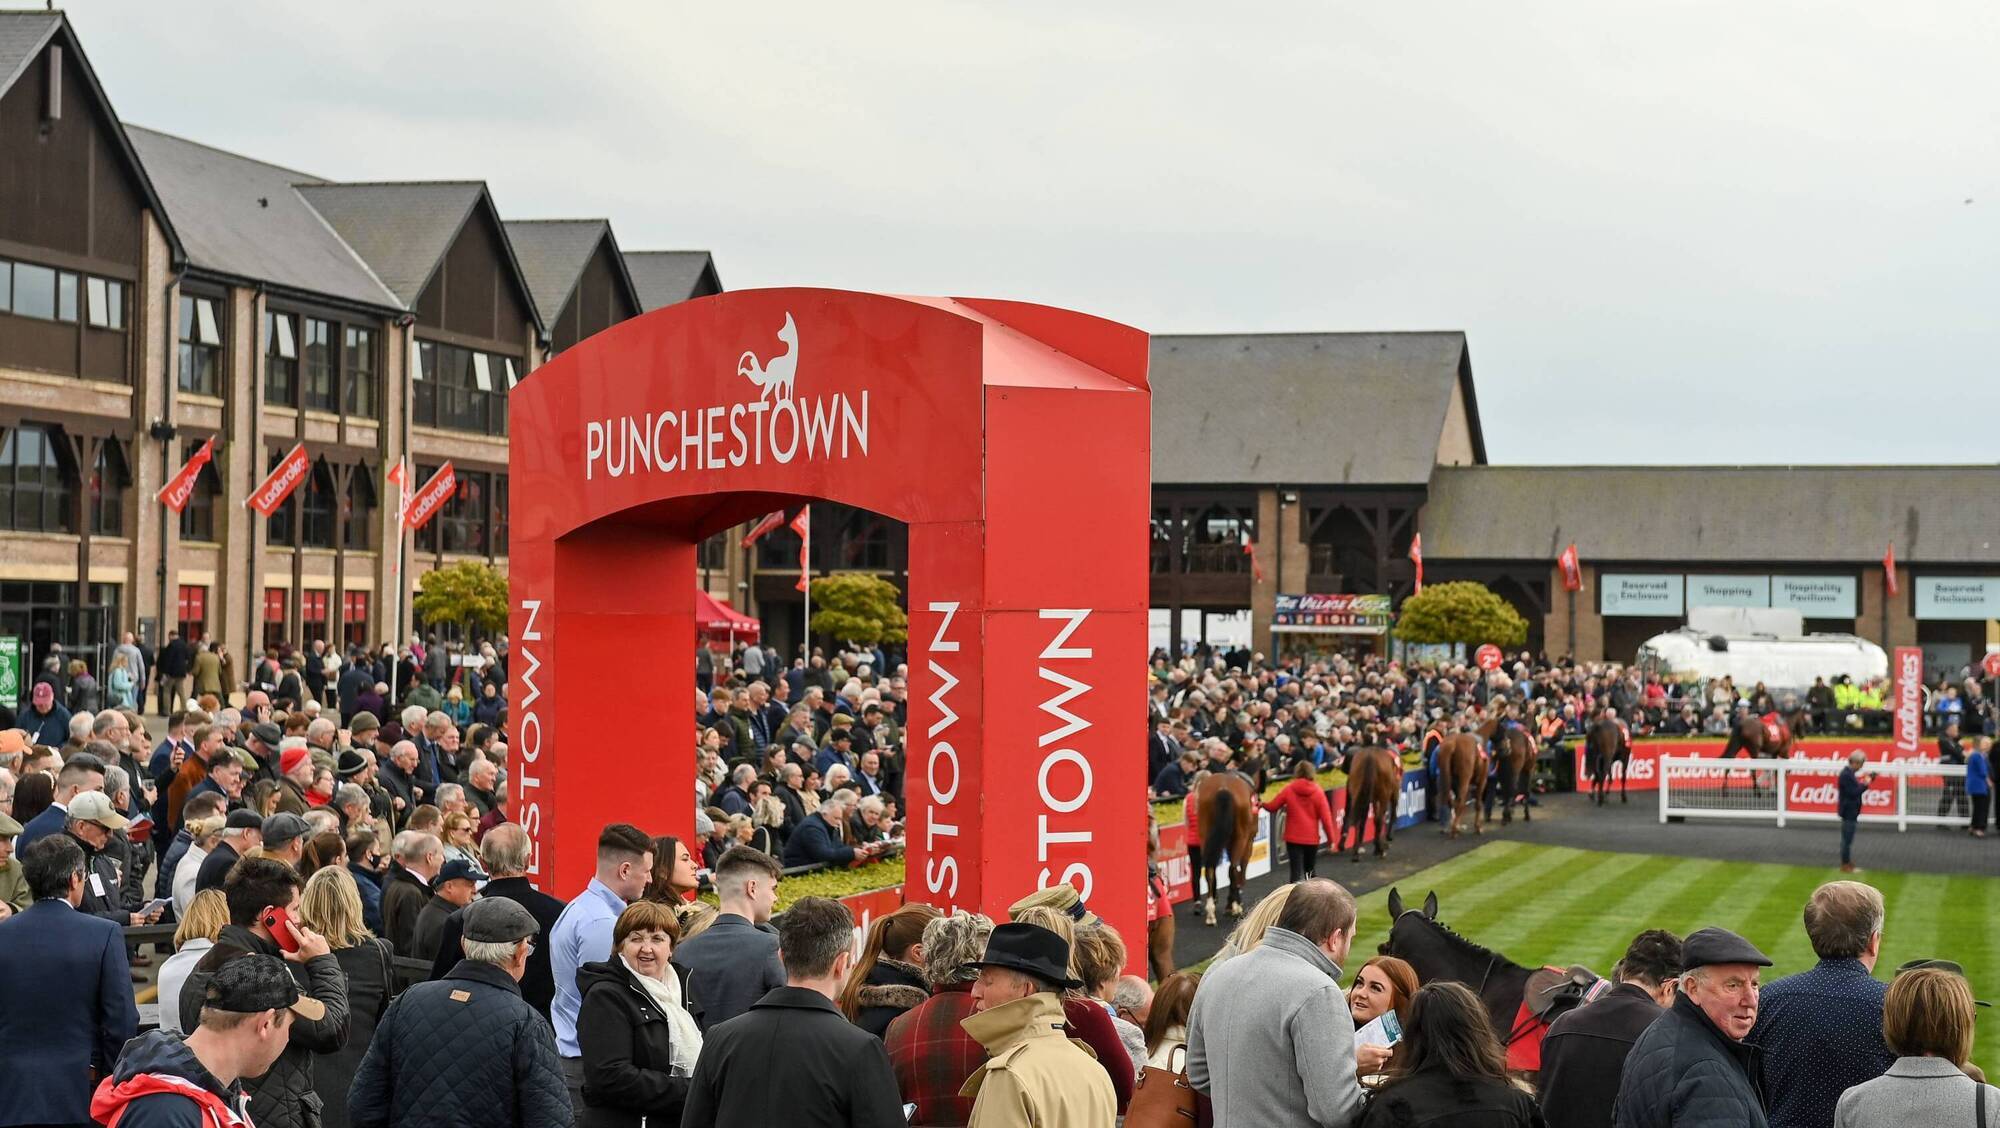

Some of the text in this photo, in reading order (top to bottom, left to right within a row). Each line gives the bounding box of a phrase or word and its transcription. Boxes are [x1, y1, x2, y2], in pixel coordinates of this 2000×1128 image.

[586, 390, 868, 480] PUNCHESTOWN
[1621, 581, 1667, 590] Reserved
[1784, 582, 1842, 594] Hospitality
[1935, 583, 1984, 592] Reserved
[1620, 591, 1668, 600] Enclosure
[1703, 585, 1752, 597] Shopping
[1790, 593, 1836, 602] Pavilions
[1897, 653, 1919, 751] Ladbrokes
